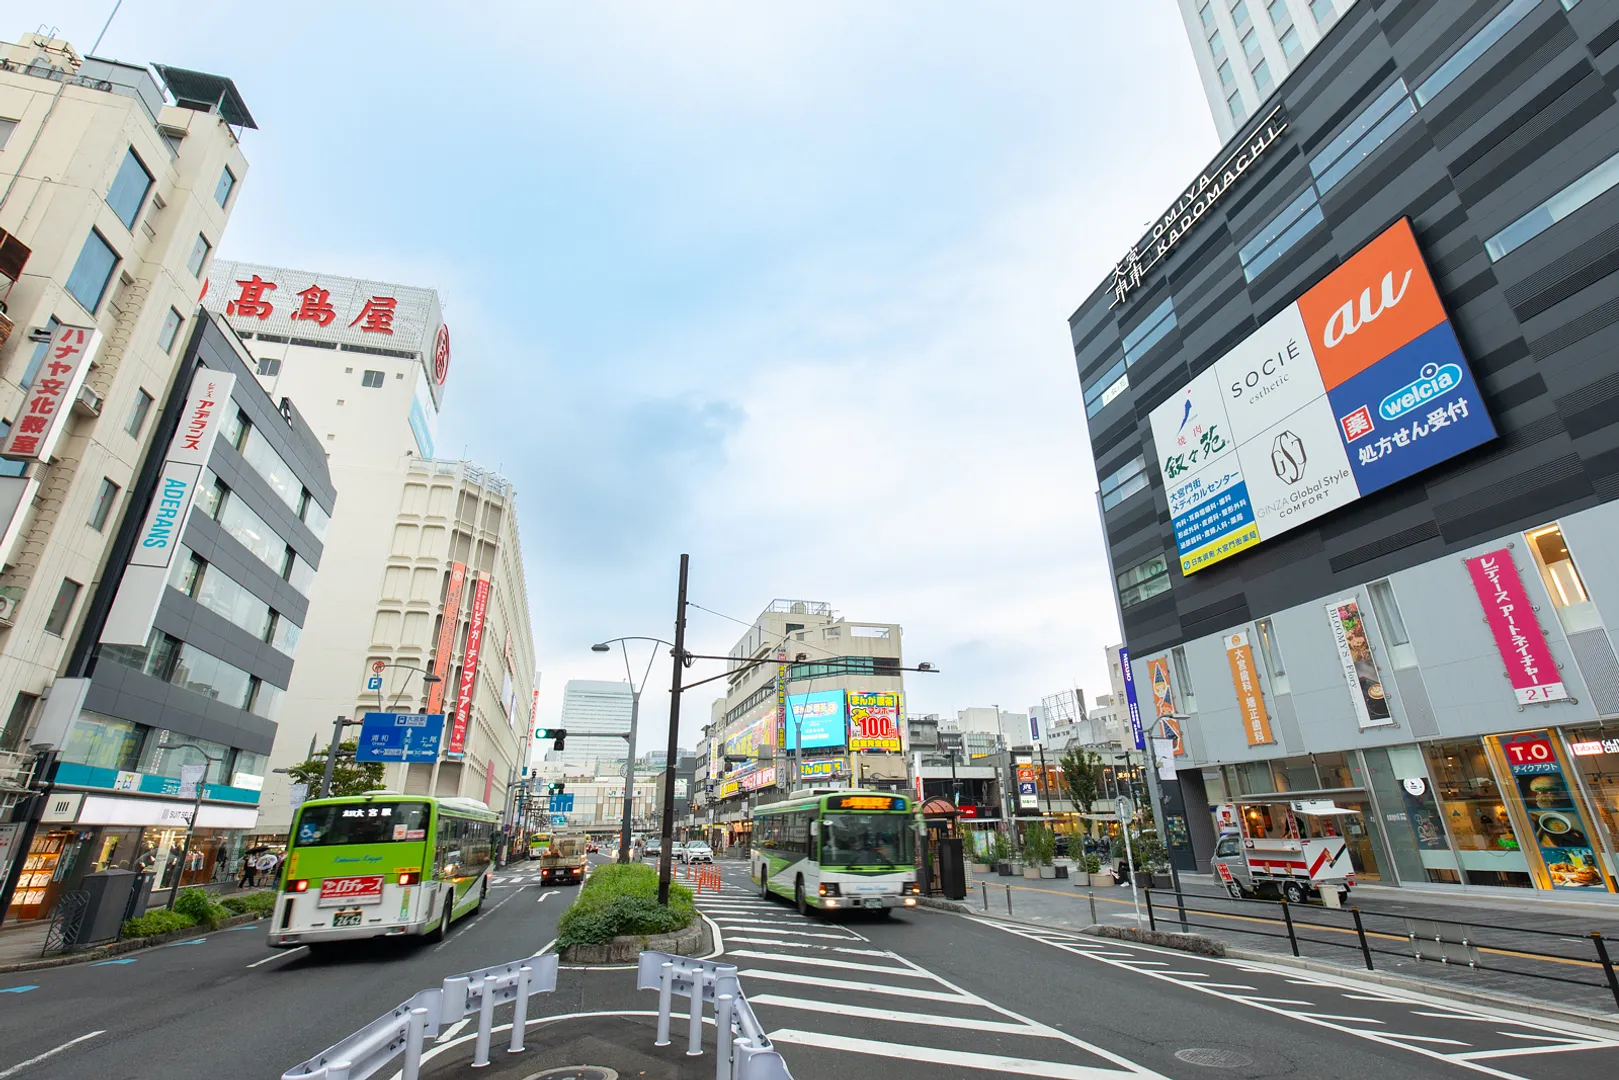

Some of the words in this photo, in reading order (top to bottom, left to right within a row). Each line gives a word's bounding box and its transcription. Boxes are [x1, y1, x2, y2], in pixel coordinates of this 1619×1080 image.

[1153, 173, 1211, 239] OMIYA
[1156, 126, 1278, 257] KADOMACHI
[1322, 267, 1413, 349] au
[8, 329, 84, 455] ハナヤ文化教室
[1230, 338, 1300, 398] SOCIÉ
[1249, 372, 1290, 405] esthetic
[1384, 372, 1453, 416] welcia
[181, 399, 215, 451] アデランス
[1346, 411, 1370, 437] 薬
[1358, 397, 1469, 466] 処方せん受付
[142, 477, 187, 549] ADERANS
[1170, 478, 1201, 502] 大宮門街
[1172, 471, 1239, 514] メディカルセンター
[1257, 498, 1289, 519] GINZA
[1289, 480, 1322, 503] Global
[1323, 469, 1349, 486] Style
[1280, 489, 1329, 518] COMFORT
[466, 611, 484, 669] ビアガーデン
[1480, 557, 1511, 604] レディース
[1499, 603, 1539, 685] アートネイチャー
[457, 671, 473, 722] マイアミ
[1525, 687, 1554, 701] 2F
[1513, 763, 1558, 773] テイクアウト
